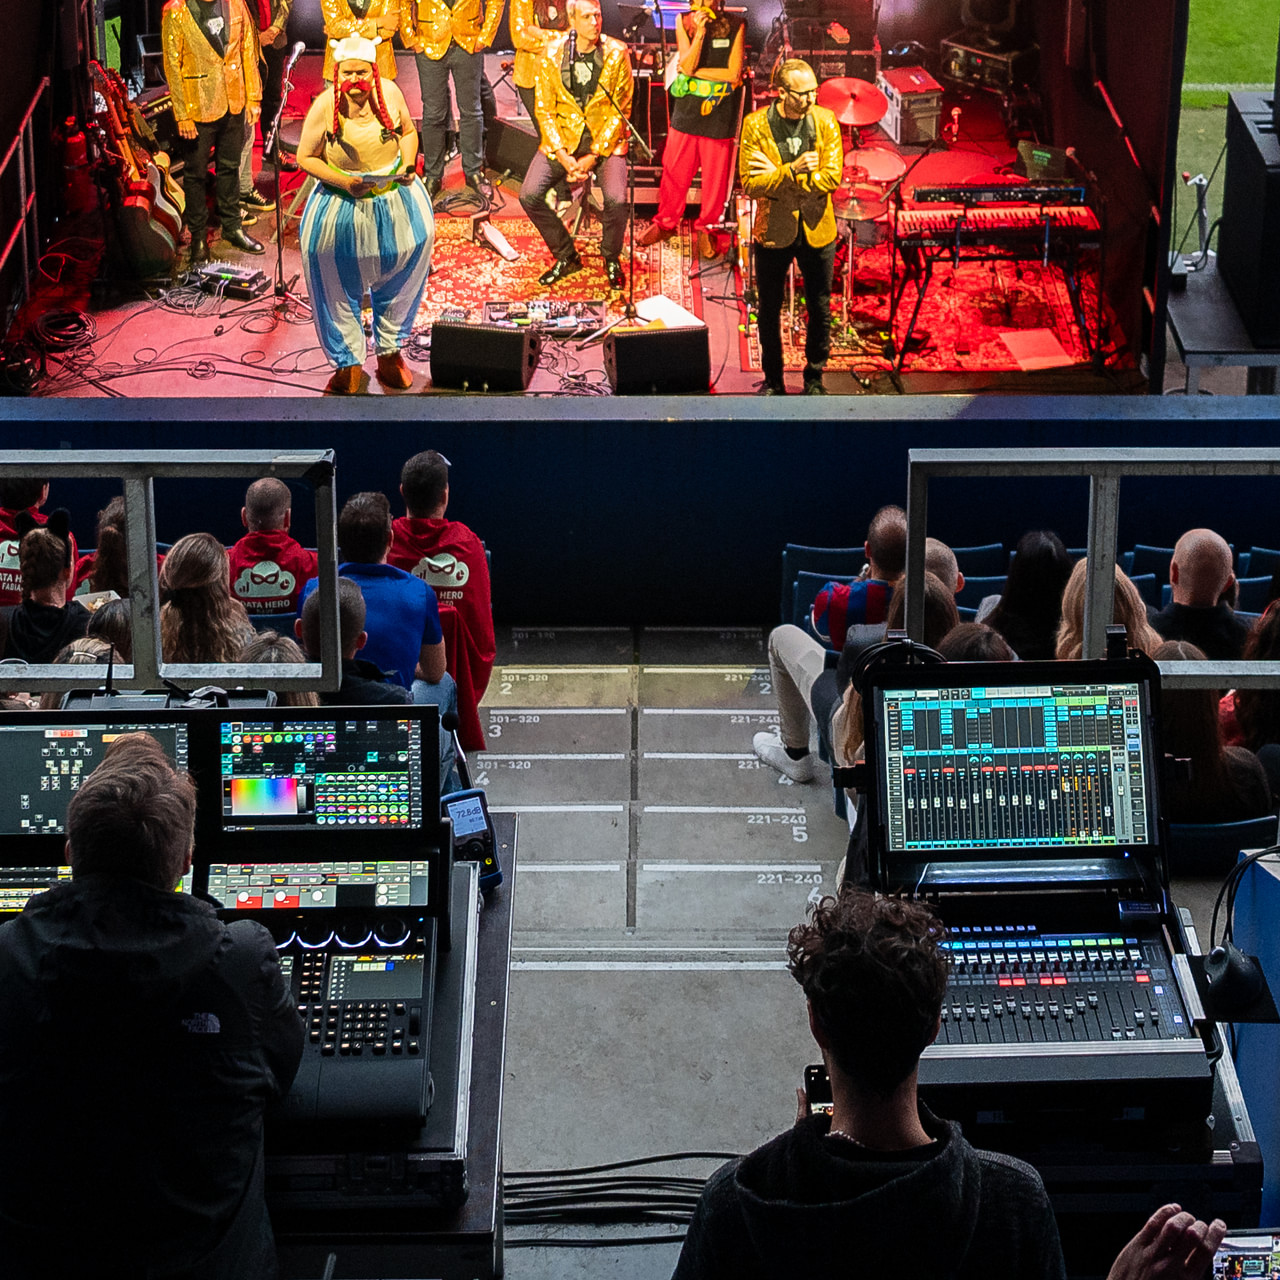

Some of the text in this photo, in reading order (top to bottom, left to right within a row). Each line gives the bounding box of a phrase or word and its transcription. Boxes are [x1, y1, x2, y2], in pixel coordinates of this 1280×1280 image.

[439, 591, 463, 600] HERO
[265, 599, 290, 609] HERO
[501, 674, 548, 682] 301-320
[724, 674, 771, 682] 221-240
[500, 683, 512, 695] 2
[760, 683, 772, 695] 2
[489, 715, 540, 724] 301-320
[730, 715, 781, 724] 221-240
[488, 725, 502, 738] 3
[477, 761, 531, 770] 301-320
[738, 761, 773, 769] 221-
[747, 815, 807, 824] 221-240
[792, 826, 808, 842] 5
[757, 874, 823, 884] 221-240
[807, 887, 823, 905] 6
